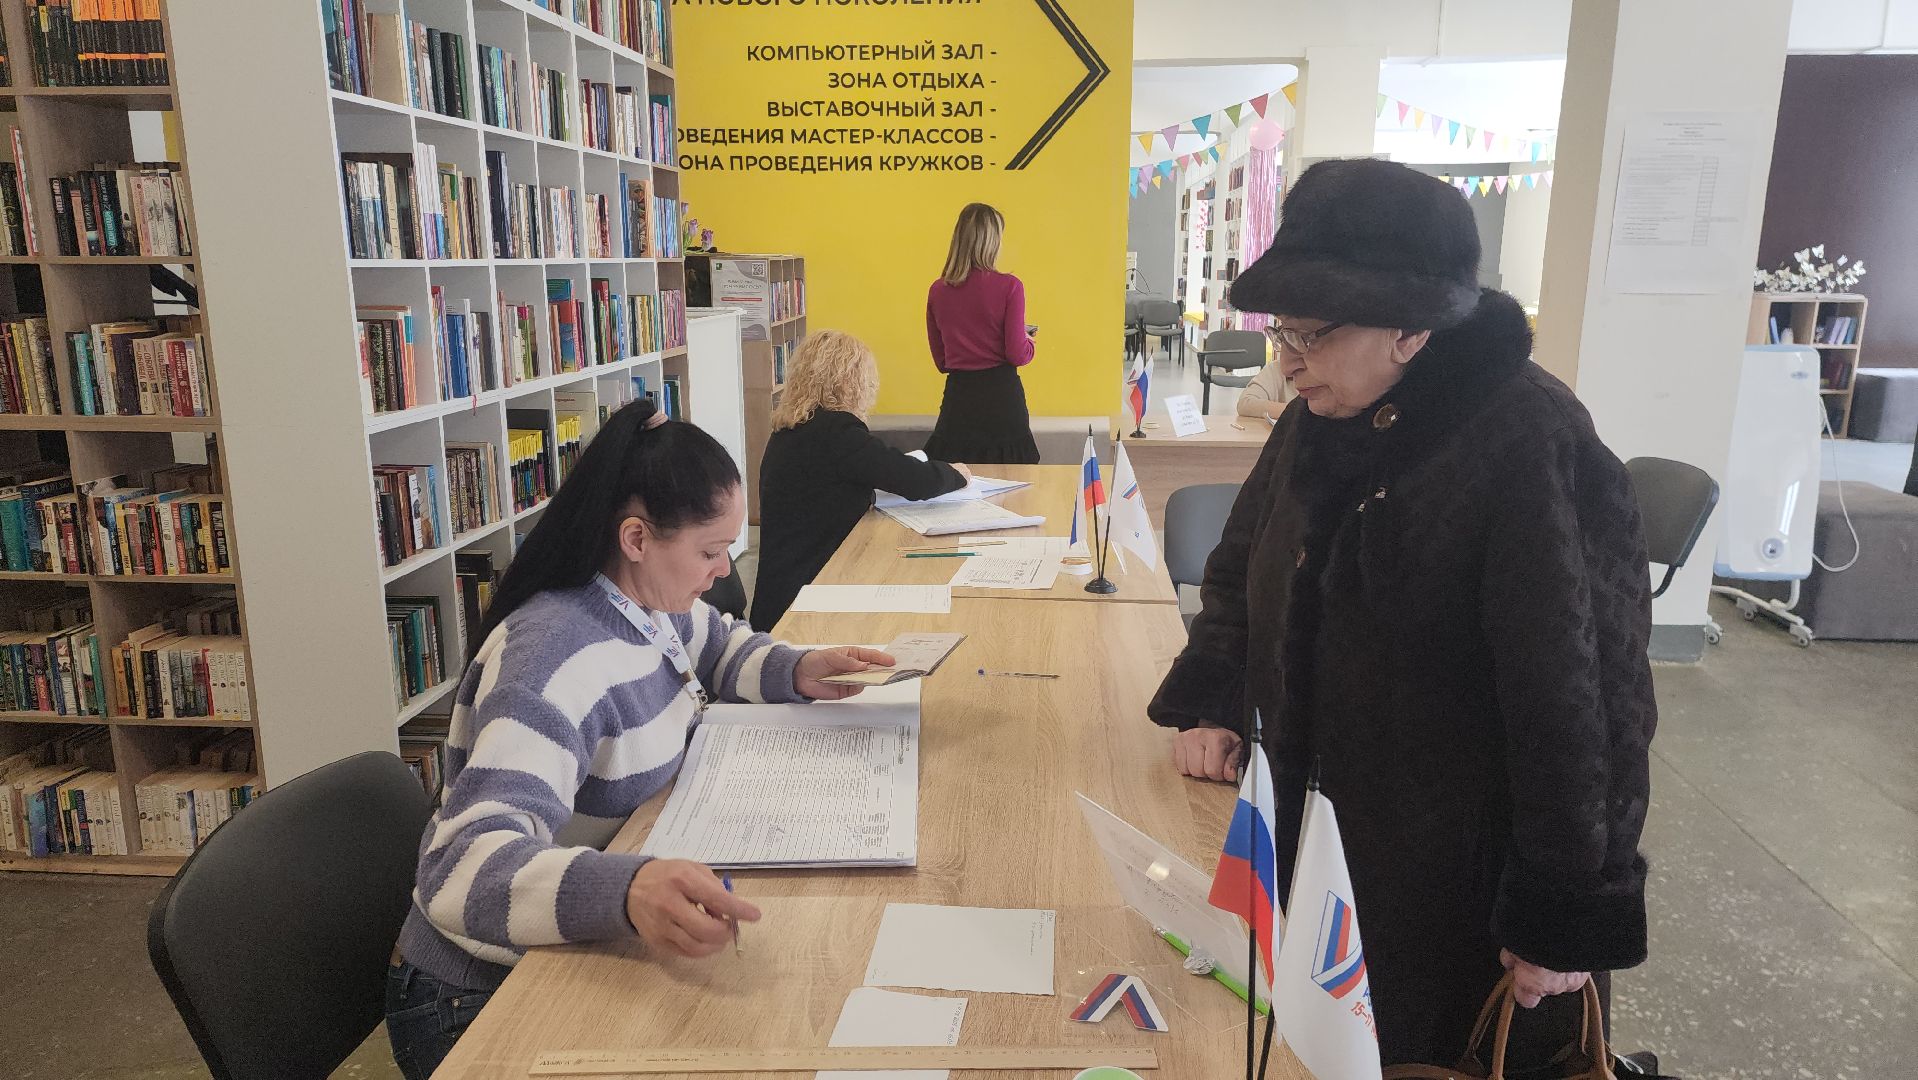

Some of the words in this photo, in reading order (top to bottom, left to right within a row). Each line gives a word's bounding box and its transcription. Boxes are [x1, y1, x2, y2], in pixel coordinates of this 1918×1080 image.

[747, 40, 935, 62] КОМПЬЮТЕРНЫЙ
[941, 44, 984, 61] ЗАЛ
[828, 72, 887, 90] ЗОНА
[892, 71, 985, 91] ОТДЫХА
[767, 97, 935, 118] ВЫСТАВОЧНЫЙ
[941, 101, 984, 117] ЗАЛ
[790, 128, 984, 145] МАСТЕР-КЛАССОВ
[678, 154, 725, 171] ОНА
[729, 155, 873, 174] ПРОВЕДЕНИЯ
[879, 155, 984, 172] КРУЖКОВ
